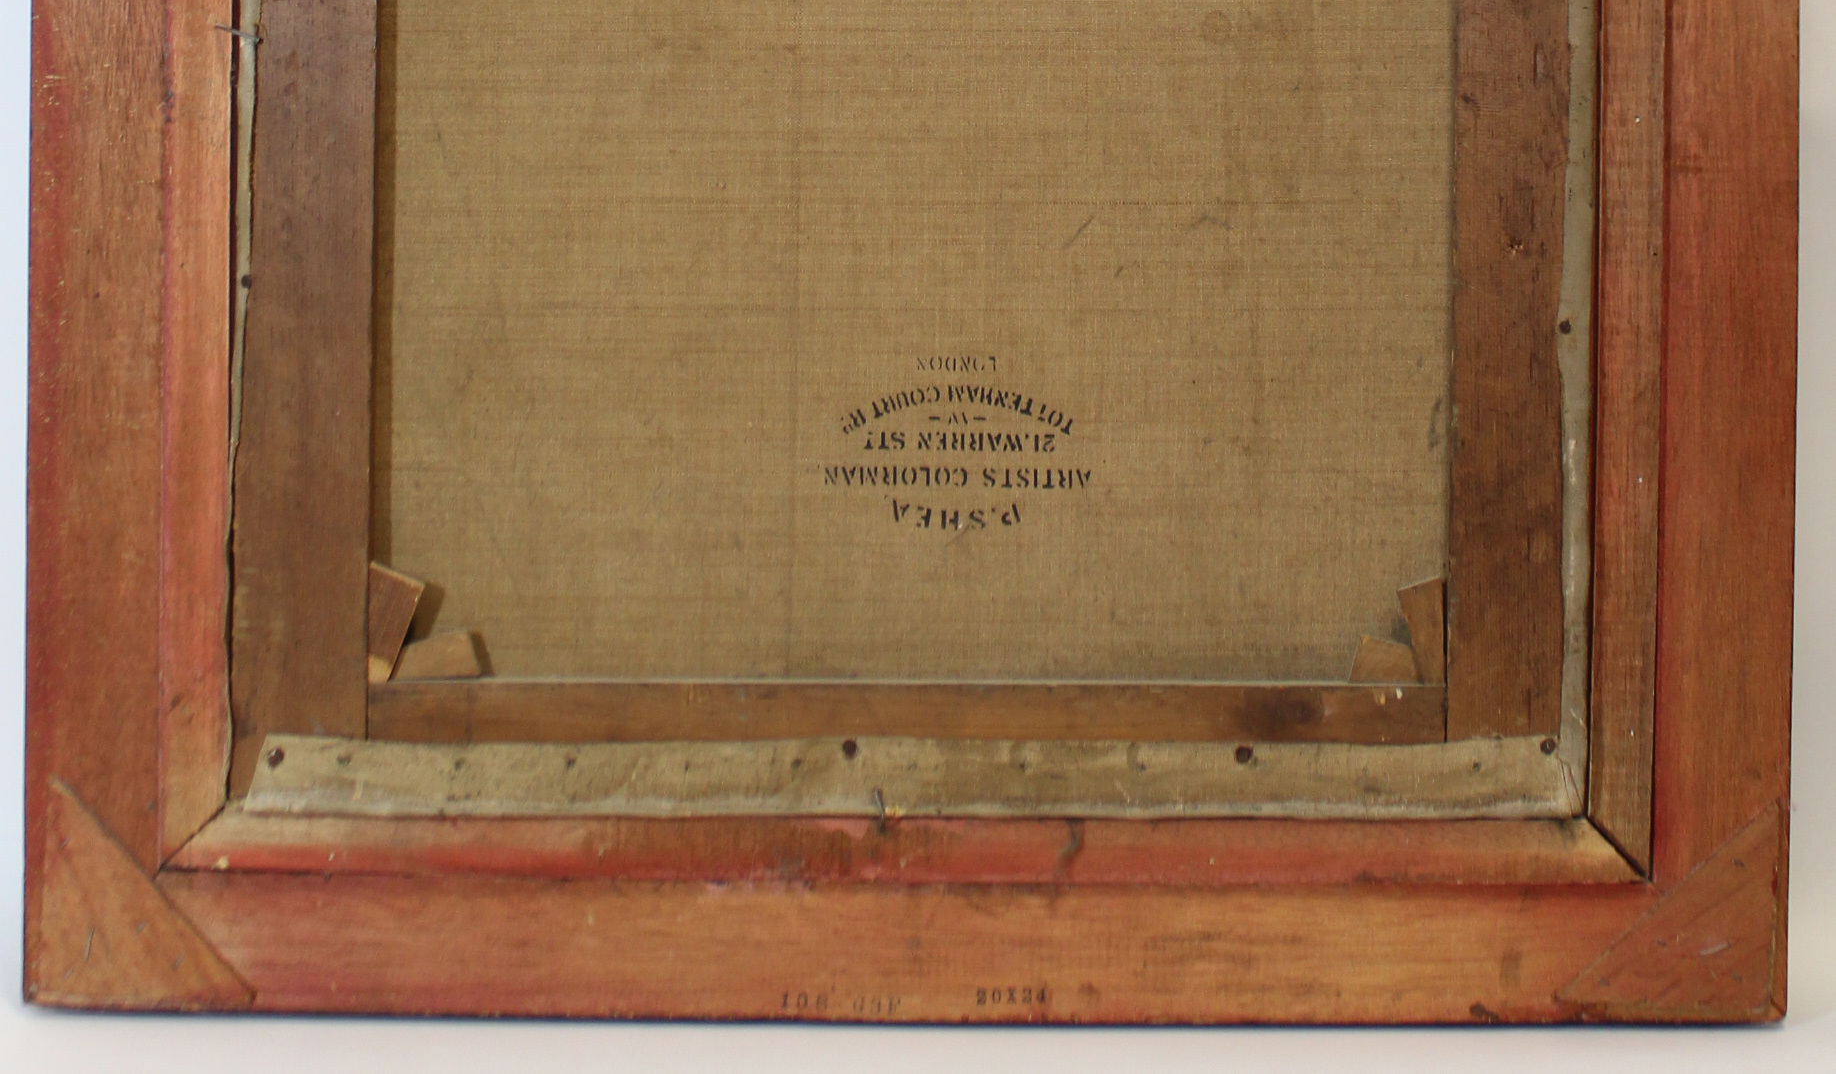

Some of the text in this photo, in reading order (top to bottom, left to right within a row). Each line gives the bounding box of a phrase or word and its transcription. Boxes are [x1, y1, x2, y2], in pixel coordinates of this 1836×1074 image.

[916, 356, 996, 372] LONDON
[870, 386, 940, 419] COURT
[948, 385, 1074, 435] TOTTENHAM
[982, 467, 1091, 489] ARTISTS
